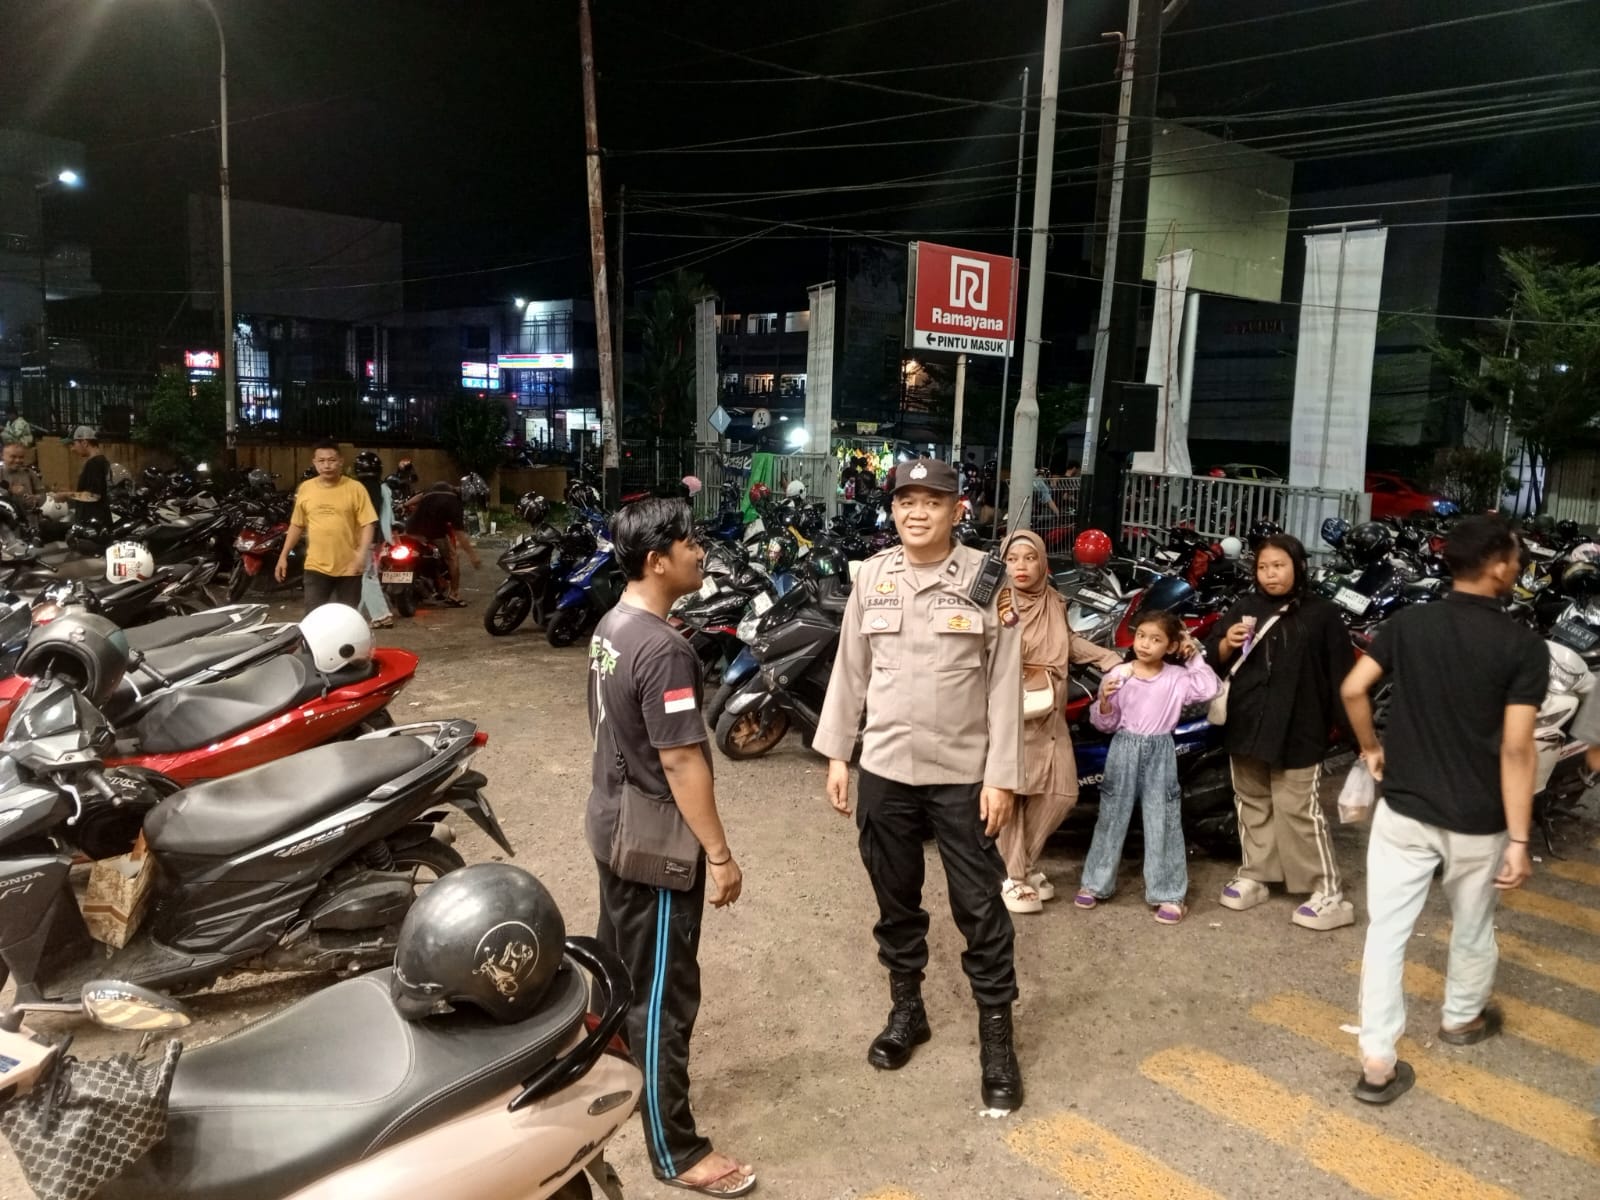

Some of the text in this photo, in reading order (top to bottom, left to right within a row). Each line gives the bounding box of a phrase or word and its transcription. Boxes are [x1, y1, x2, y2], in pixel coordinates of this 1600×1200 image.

[932, 307, 1004, 331] Ramayana
[937, 335, 1004, 353] PINTU MASUK
[938, 596, 973, 606] POL
[0, 871, 45, 887] ONDA
